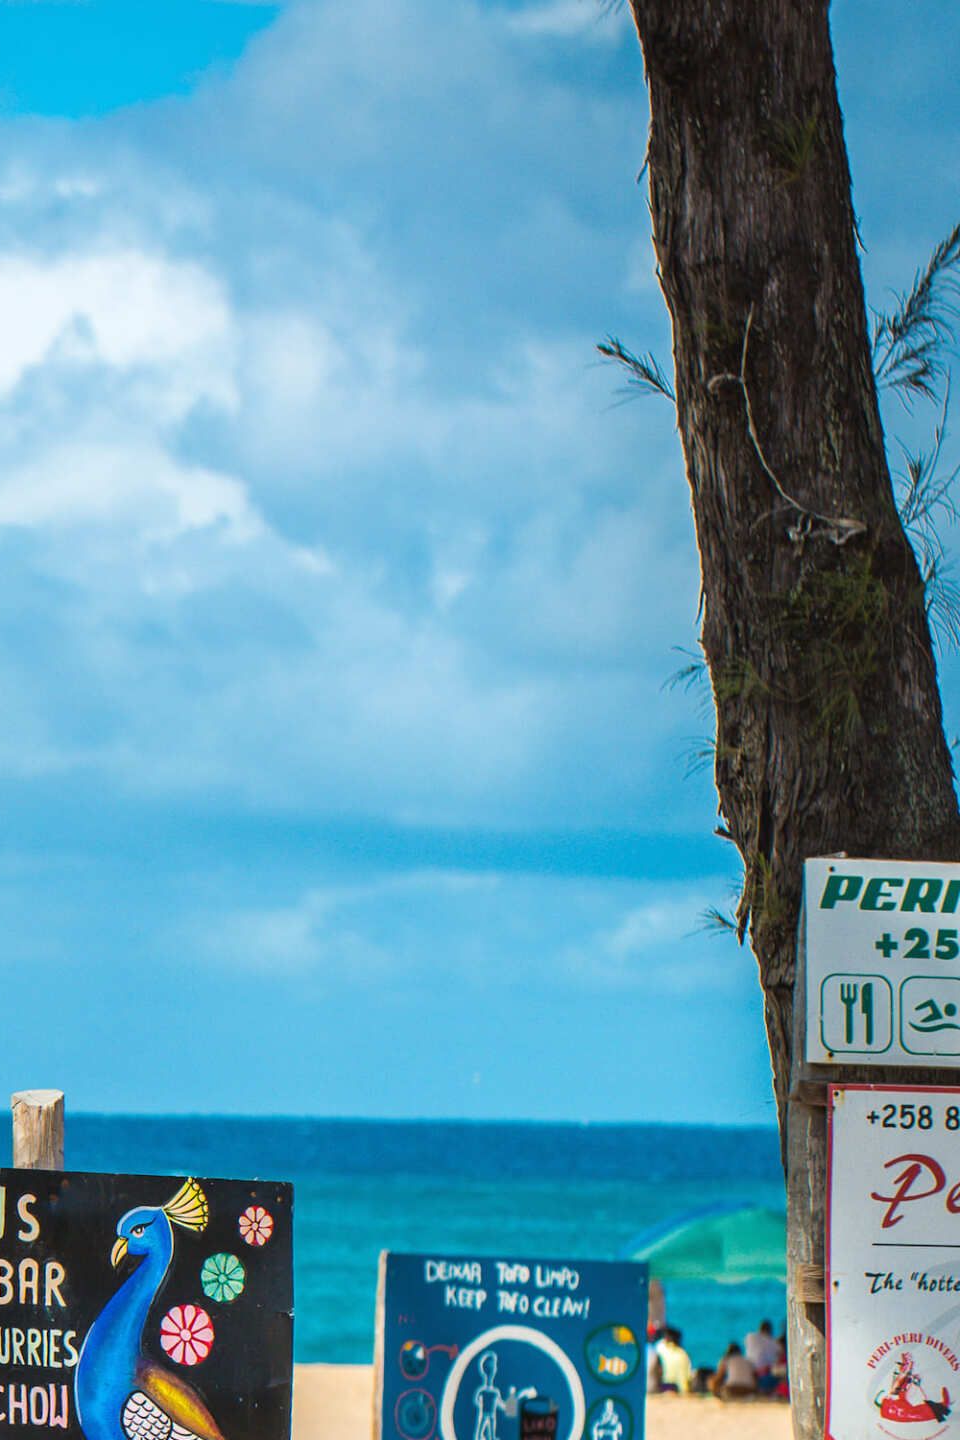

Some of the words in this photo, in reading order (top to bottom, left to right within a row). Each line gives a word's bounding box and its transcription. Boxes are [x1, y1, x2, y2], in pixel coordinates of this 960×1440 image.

[875, 927, 960, 960] +25
[866, 1104, 933, 1130] +258
[425, 1260, 482, 1285] DEIXAR
[535, 1264, 580, 1290] LIMPO
[864, 1271, 903, 1294] The
[445, 1285, 488, 1310] KEEP
[497, 1289, 529, 1315] TOFO
[533, 1296, 590, 1320] CLEAN!
[867, 1332, 923, 1369] PERI-PERI
[925, 1335, 960, 1371] DIVERS
